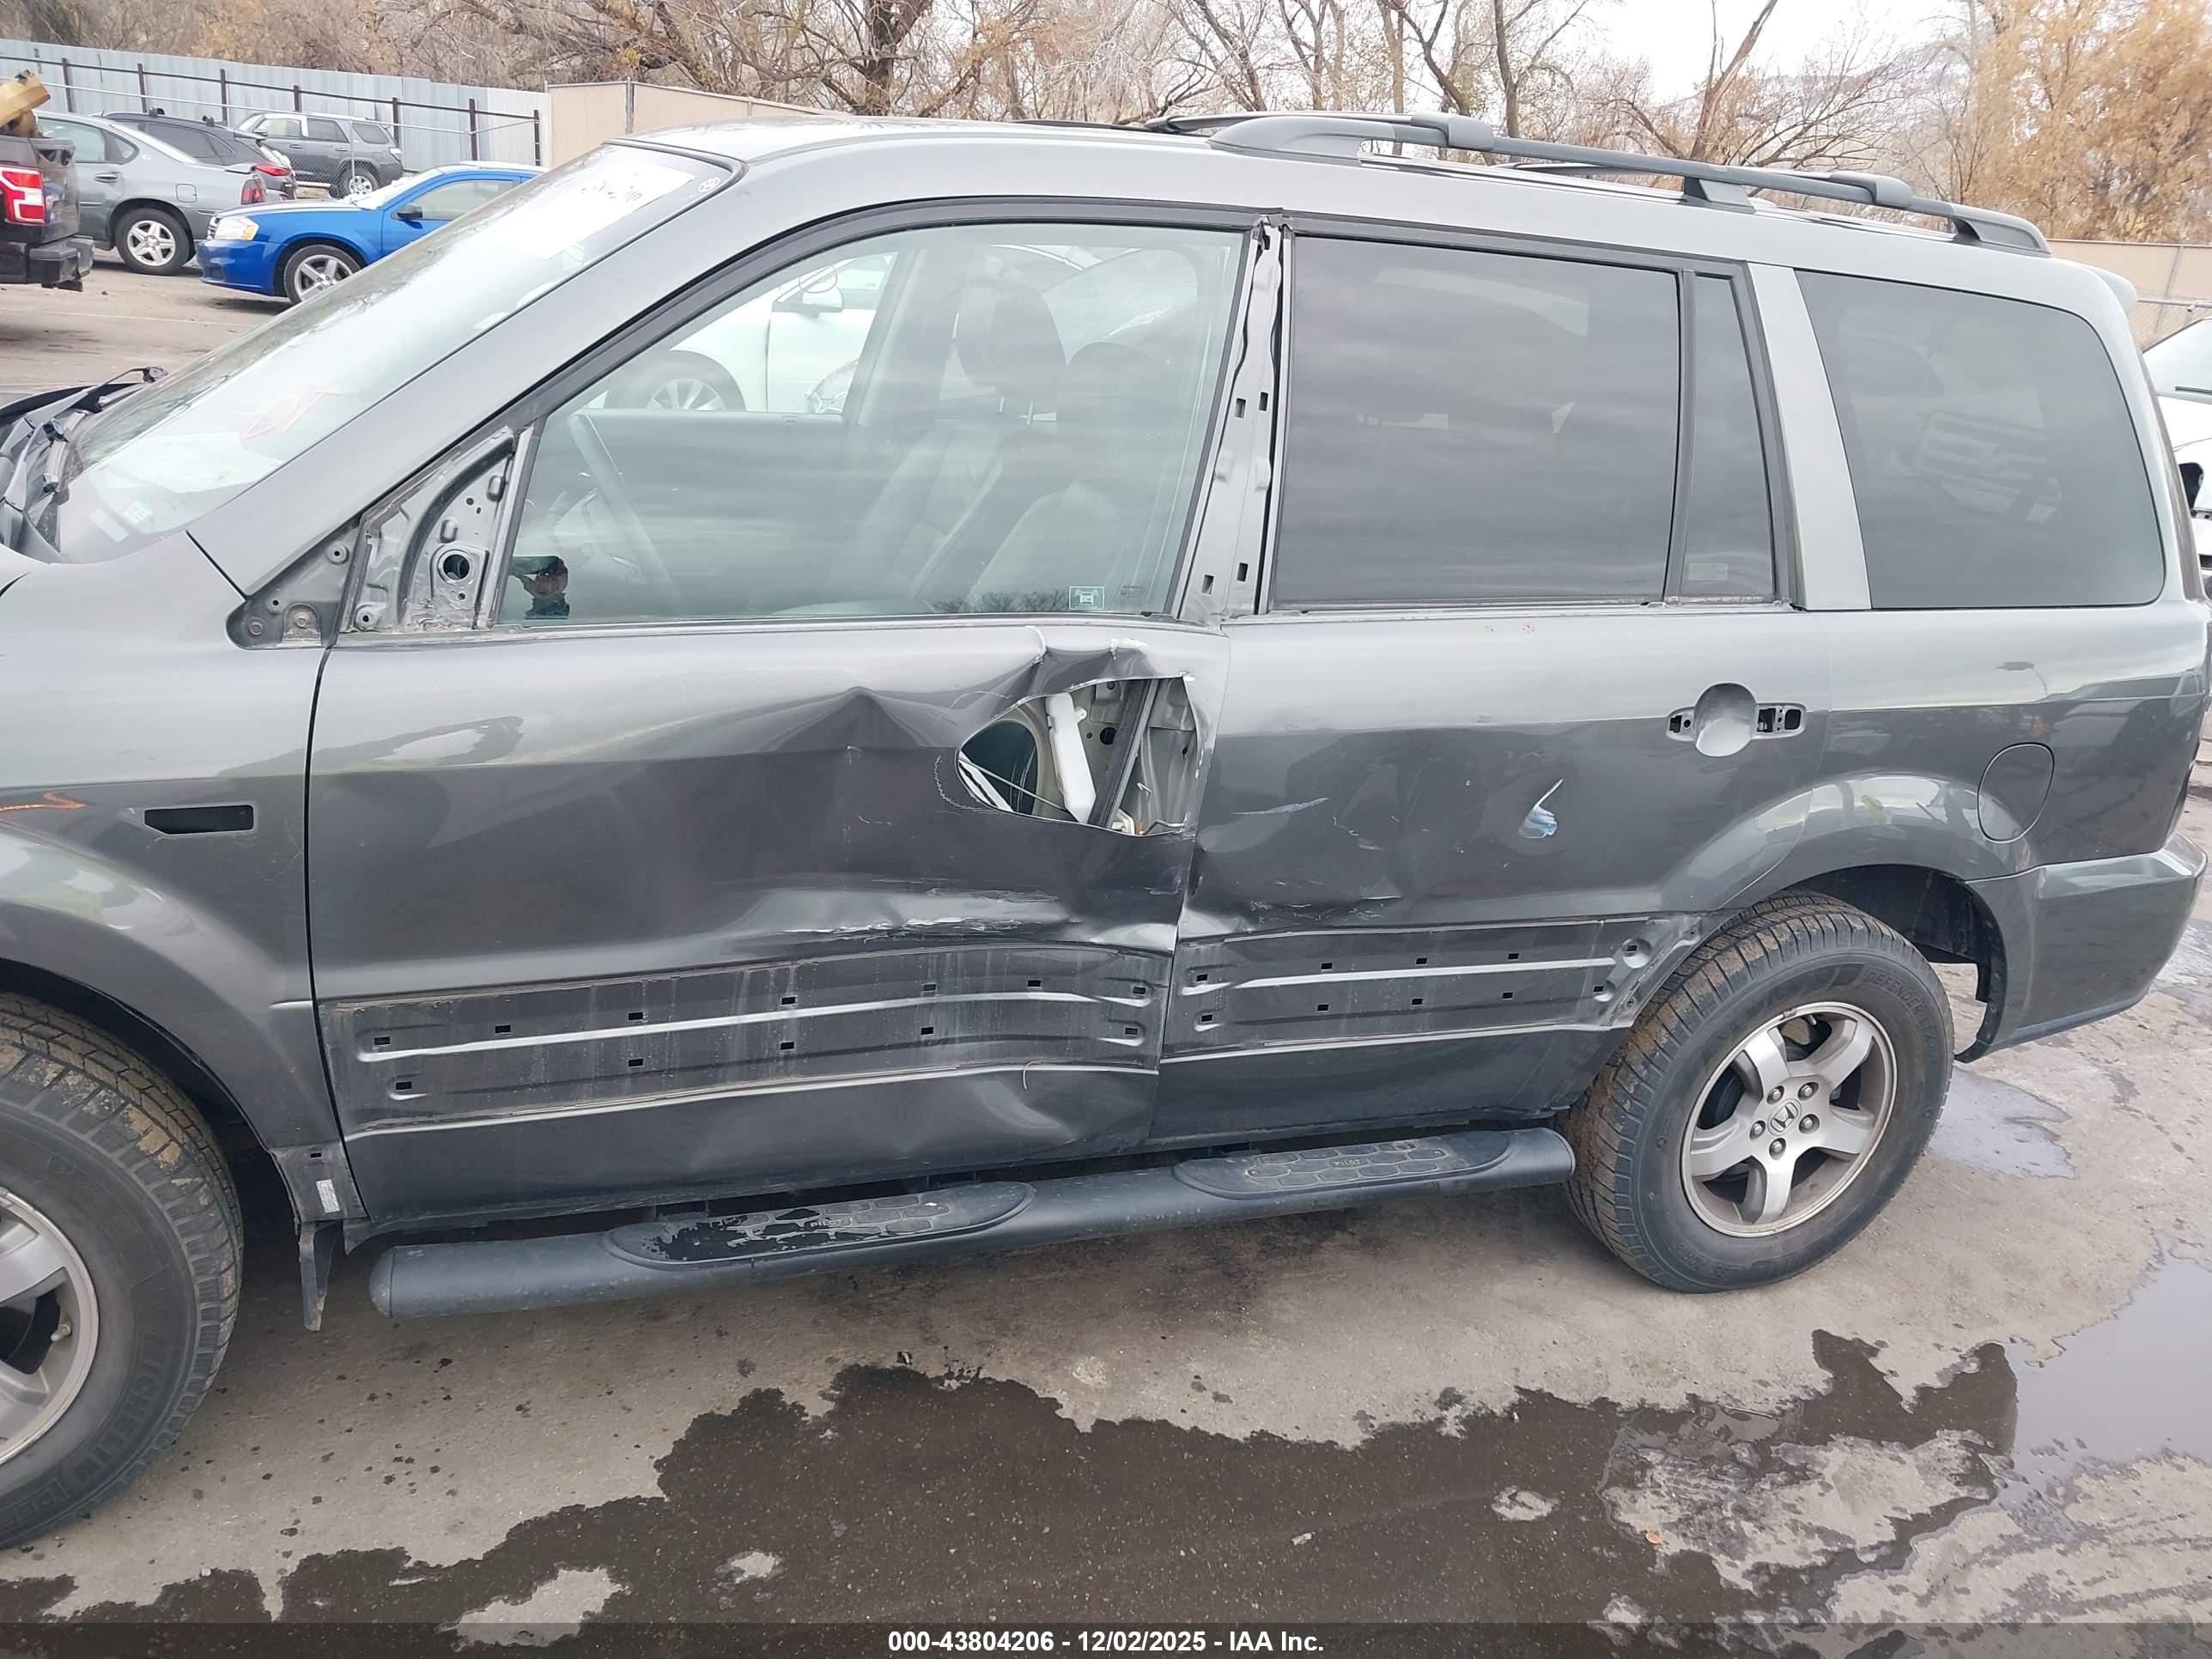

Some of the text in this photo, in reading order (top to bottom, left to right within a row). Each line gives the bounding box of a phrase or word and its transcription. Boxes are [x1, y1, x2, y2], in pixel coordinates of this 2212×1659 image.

[1865, 969, 1925, 1014] DEFENDER
[810, 1219, 843, 1228] PILOT
[65, 1334, 170, 1486] MICHELIN
